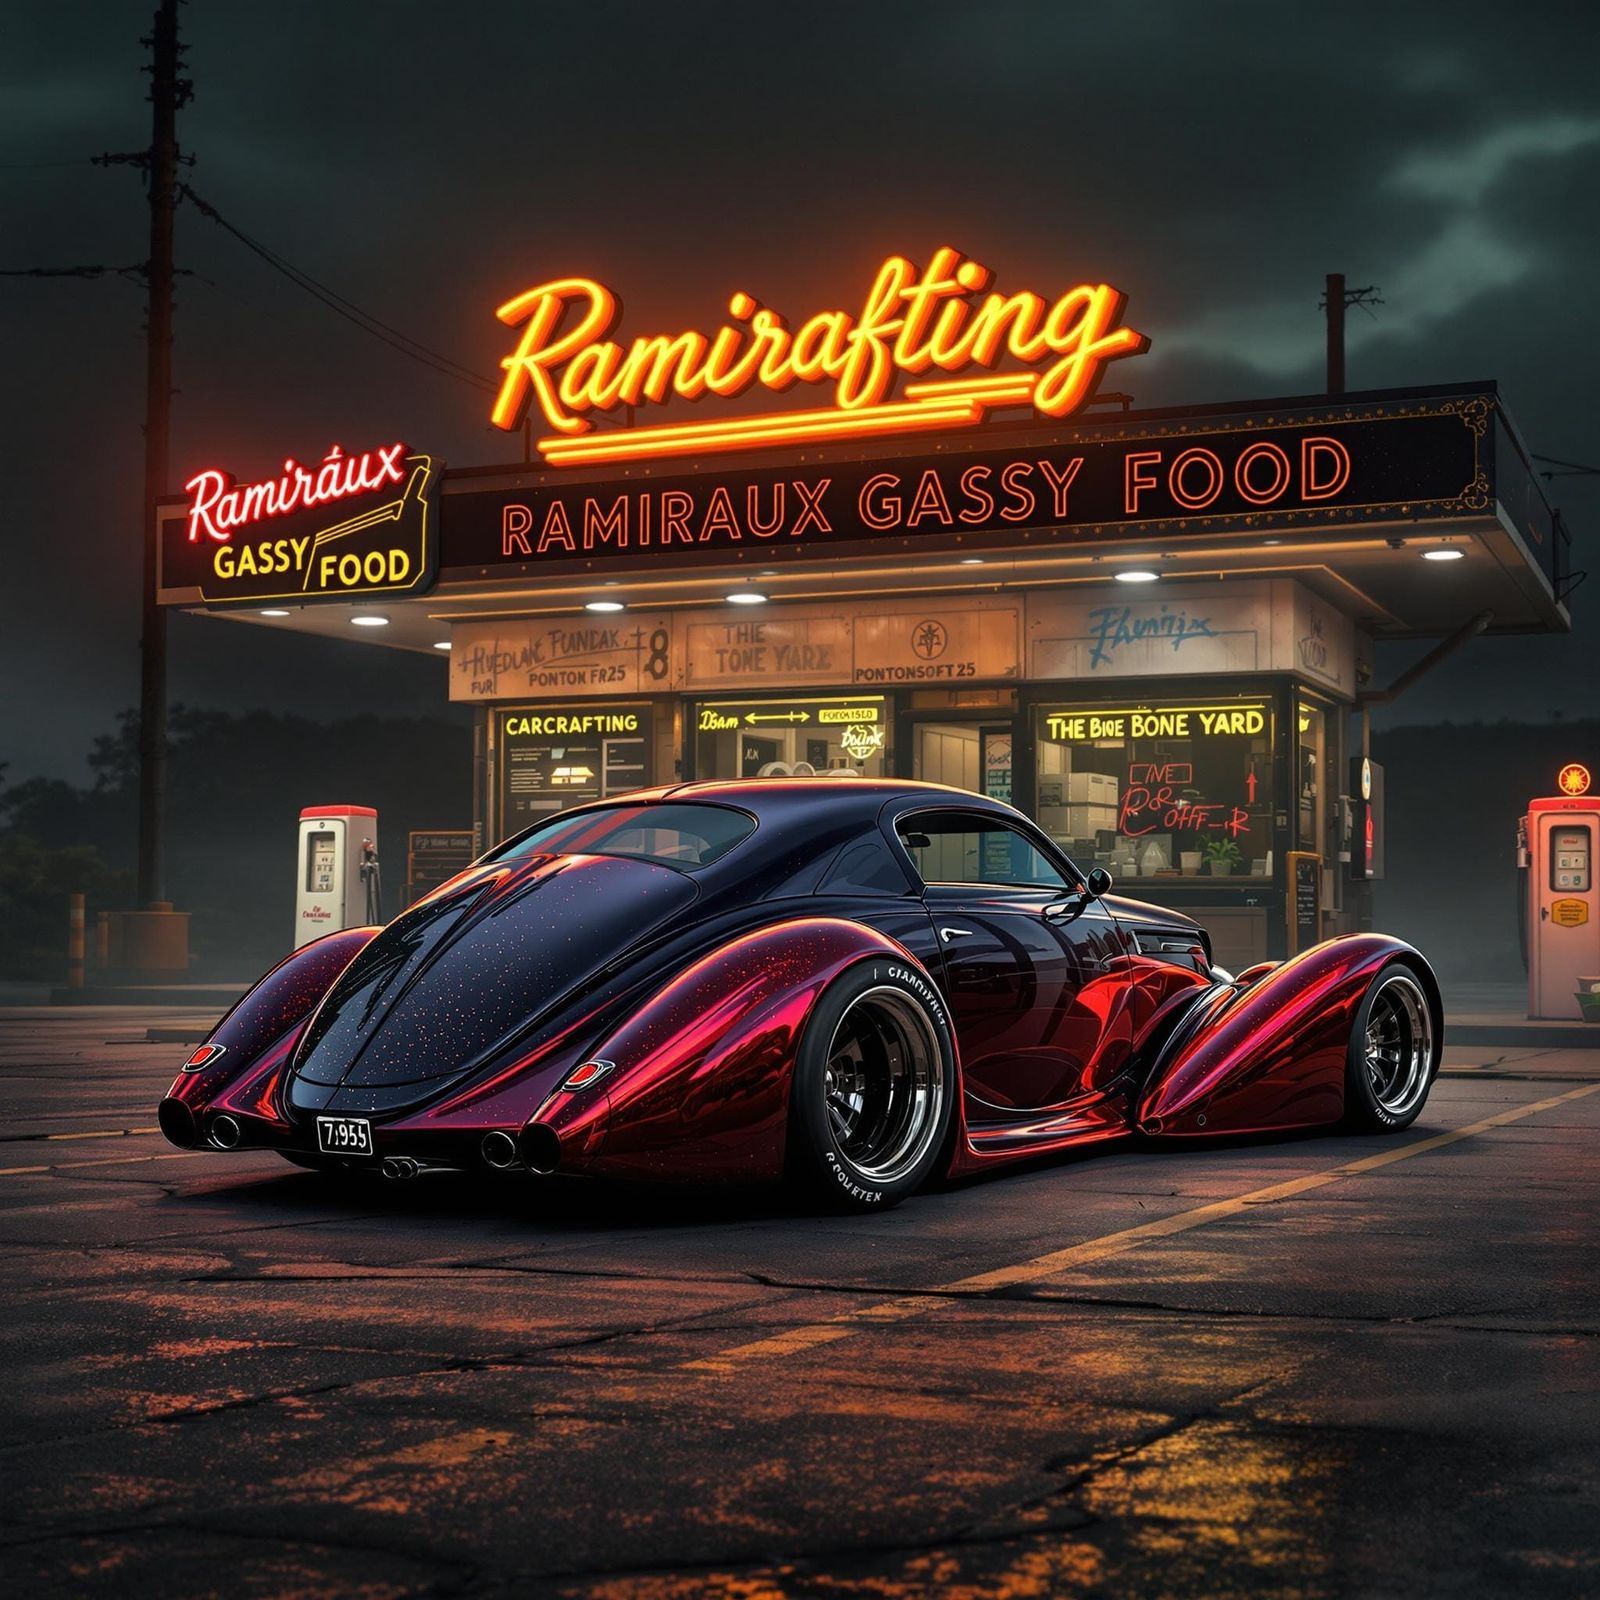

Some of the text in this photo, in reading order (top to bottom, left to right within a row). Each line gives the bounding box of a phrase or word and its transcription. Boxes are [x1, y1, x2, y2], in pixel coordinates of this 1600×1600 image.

[491, 246, 1136, 418] Ramirafting
[502, 436, 1351, 556] RAMIRAUX GASSY FOOD
[213, 536, 310, 579] GASSY
[320, 549, 410, 588] FOOD
[855, 663, 976, 681] PONTONSOFT 25
[506, 714, 638, 736] CARCRAFTING
[1046, 718, 1086, 740] THE
[1131, 713, 1190, 738] BONE
[1199, 710, 1264, 735] YARD
